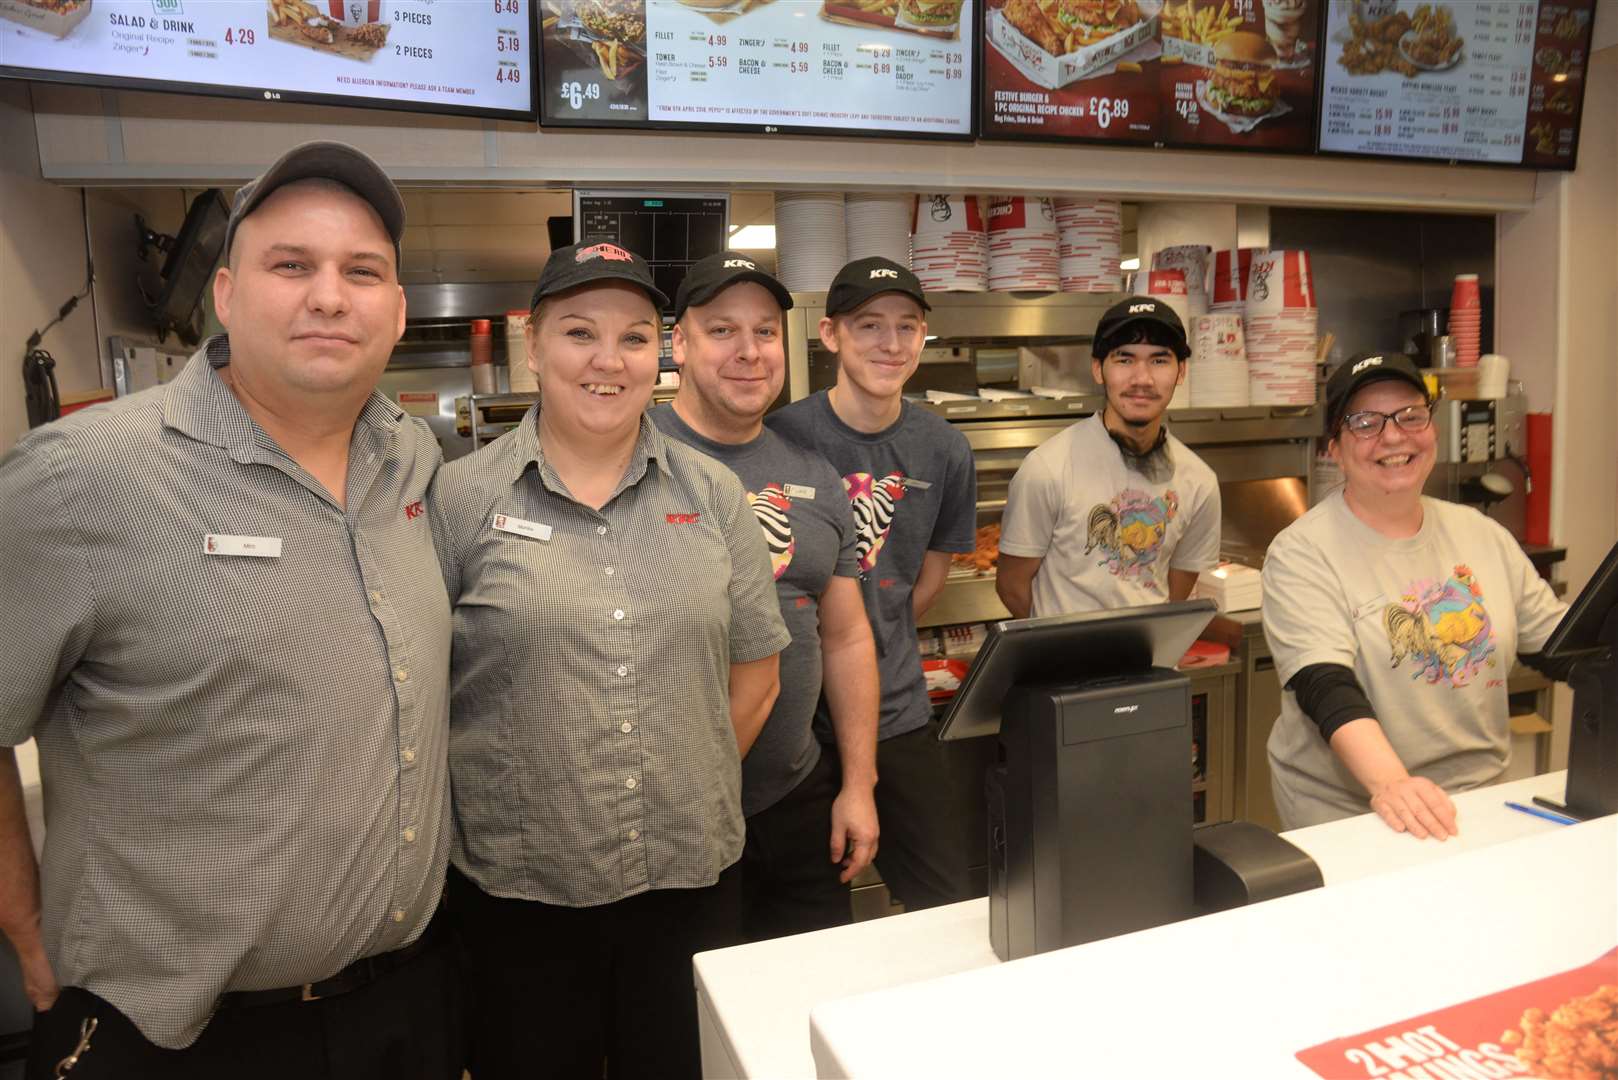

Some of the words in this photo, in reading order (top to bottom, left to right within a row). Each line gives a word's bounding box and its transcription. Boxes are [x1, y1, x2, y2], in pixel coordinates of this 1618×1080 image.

[110, 13, 145, 28] SALAD
[149, 18, 159, 30] &
[163, 19, 195, 33] DRINK
[394, 11, 400, 21] 3
[402, 11, 432, 25] PIECES
[225, 27, 255, 45] 4.29
[655, 31, 674, 40] FILLET
[708, 35, 727, 46] 4.99
[497, 36, 520, 52] 5.19
[396, 45, 401, 56] 2
[404, 46, 433, 59] PIECES
[656, 53, 675, 61] TOWER
[708, 56, 727, 68] 5.59
[739, 58, 759, 66] BACON
[496, 68, 520, 83] 4.49
[560, 82, 600, 110] £6.49
[995, 91, 1018, 101] FESTIVE
[1020, 92, 1043, 103] BURGER
[999, 103, 1008, 112] PC
[1009, 103, 1036, 113] ORIGINAL
[1037, 105, 1058, 115] RECIPE
[1059, 106, 1084, 116] CHICKEN
[1089, 96, 1129, 128] £6.89
[723, 259, 755, 271] KFC
[870, 269, 898, 279] KFC
[1128, 303, 1155, 314] KFC
[1352, 356, 1384, 375] KFC
[1364, 1025, 1461, 1069] HOT
[1344, 1048, 1390, 1076] 2
[1370, 1042, 1530, 1080] INGS
